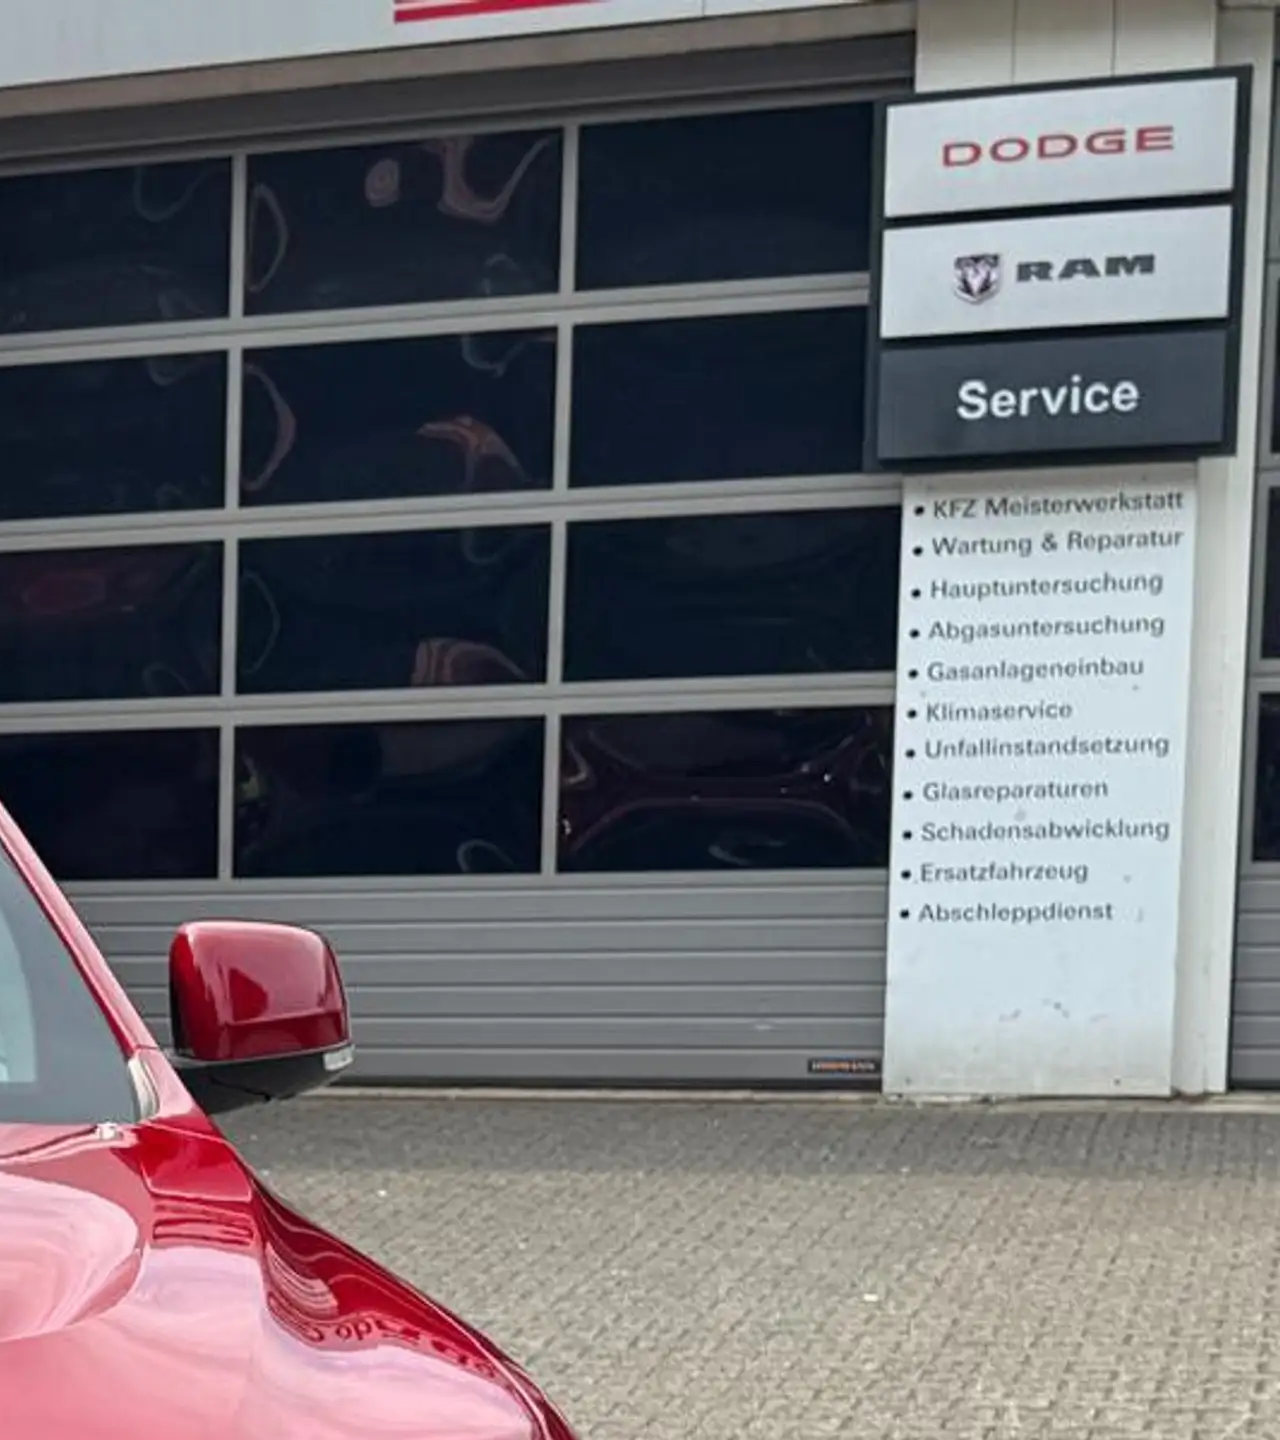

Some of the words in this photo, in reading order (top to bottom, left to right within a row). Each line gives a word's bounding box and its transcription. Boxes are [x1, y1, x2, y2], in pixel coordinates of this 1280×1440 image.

[943, 126, 1174, 167] DODGE
[1016, 253, 1156, 283] RAM
[957, 374, 1139, 420] Service
[933, 499, 976, 519] KFZ
[985, 492, 1183, 517] Meisterwerkstatt
[932, 537, 1032, 557] Wartung
[1041, 532, 1058, 552] &
[1067, 530, 1184, 553] Reparatur
[930, 572, 1163, 602] Hauptuntersuchung
[928, 615, 1165, 644] Abgasuntersuchung
[927, 656, 1144, 683] Gasanlageneinbau
[926, 700, 1073, 723] Klimaservice
[925, 735, 1169, 759] Unfallinstandsetzung
[923, 781, 1108, 803] Glasreparaturen
[921, 817, 1170, 842] Schadensabwicklung
[920, 861, 1089, 884] Ersatzfahrzeug
[918, 902, 1112, 924] Abschleppdienst
